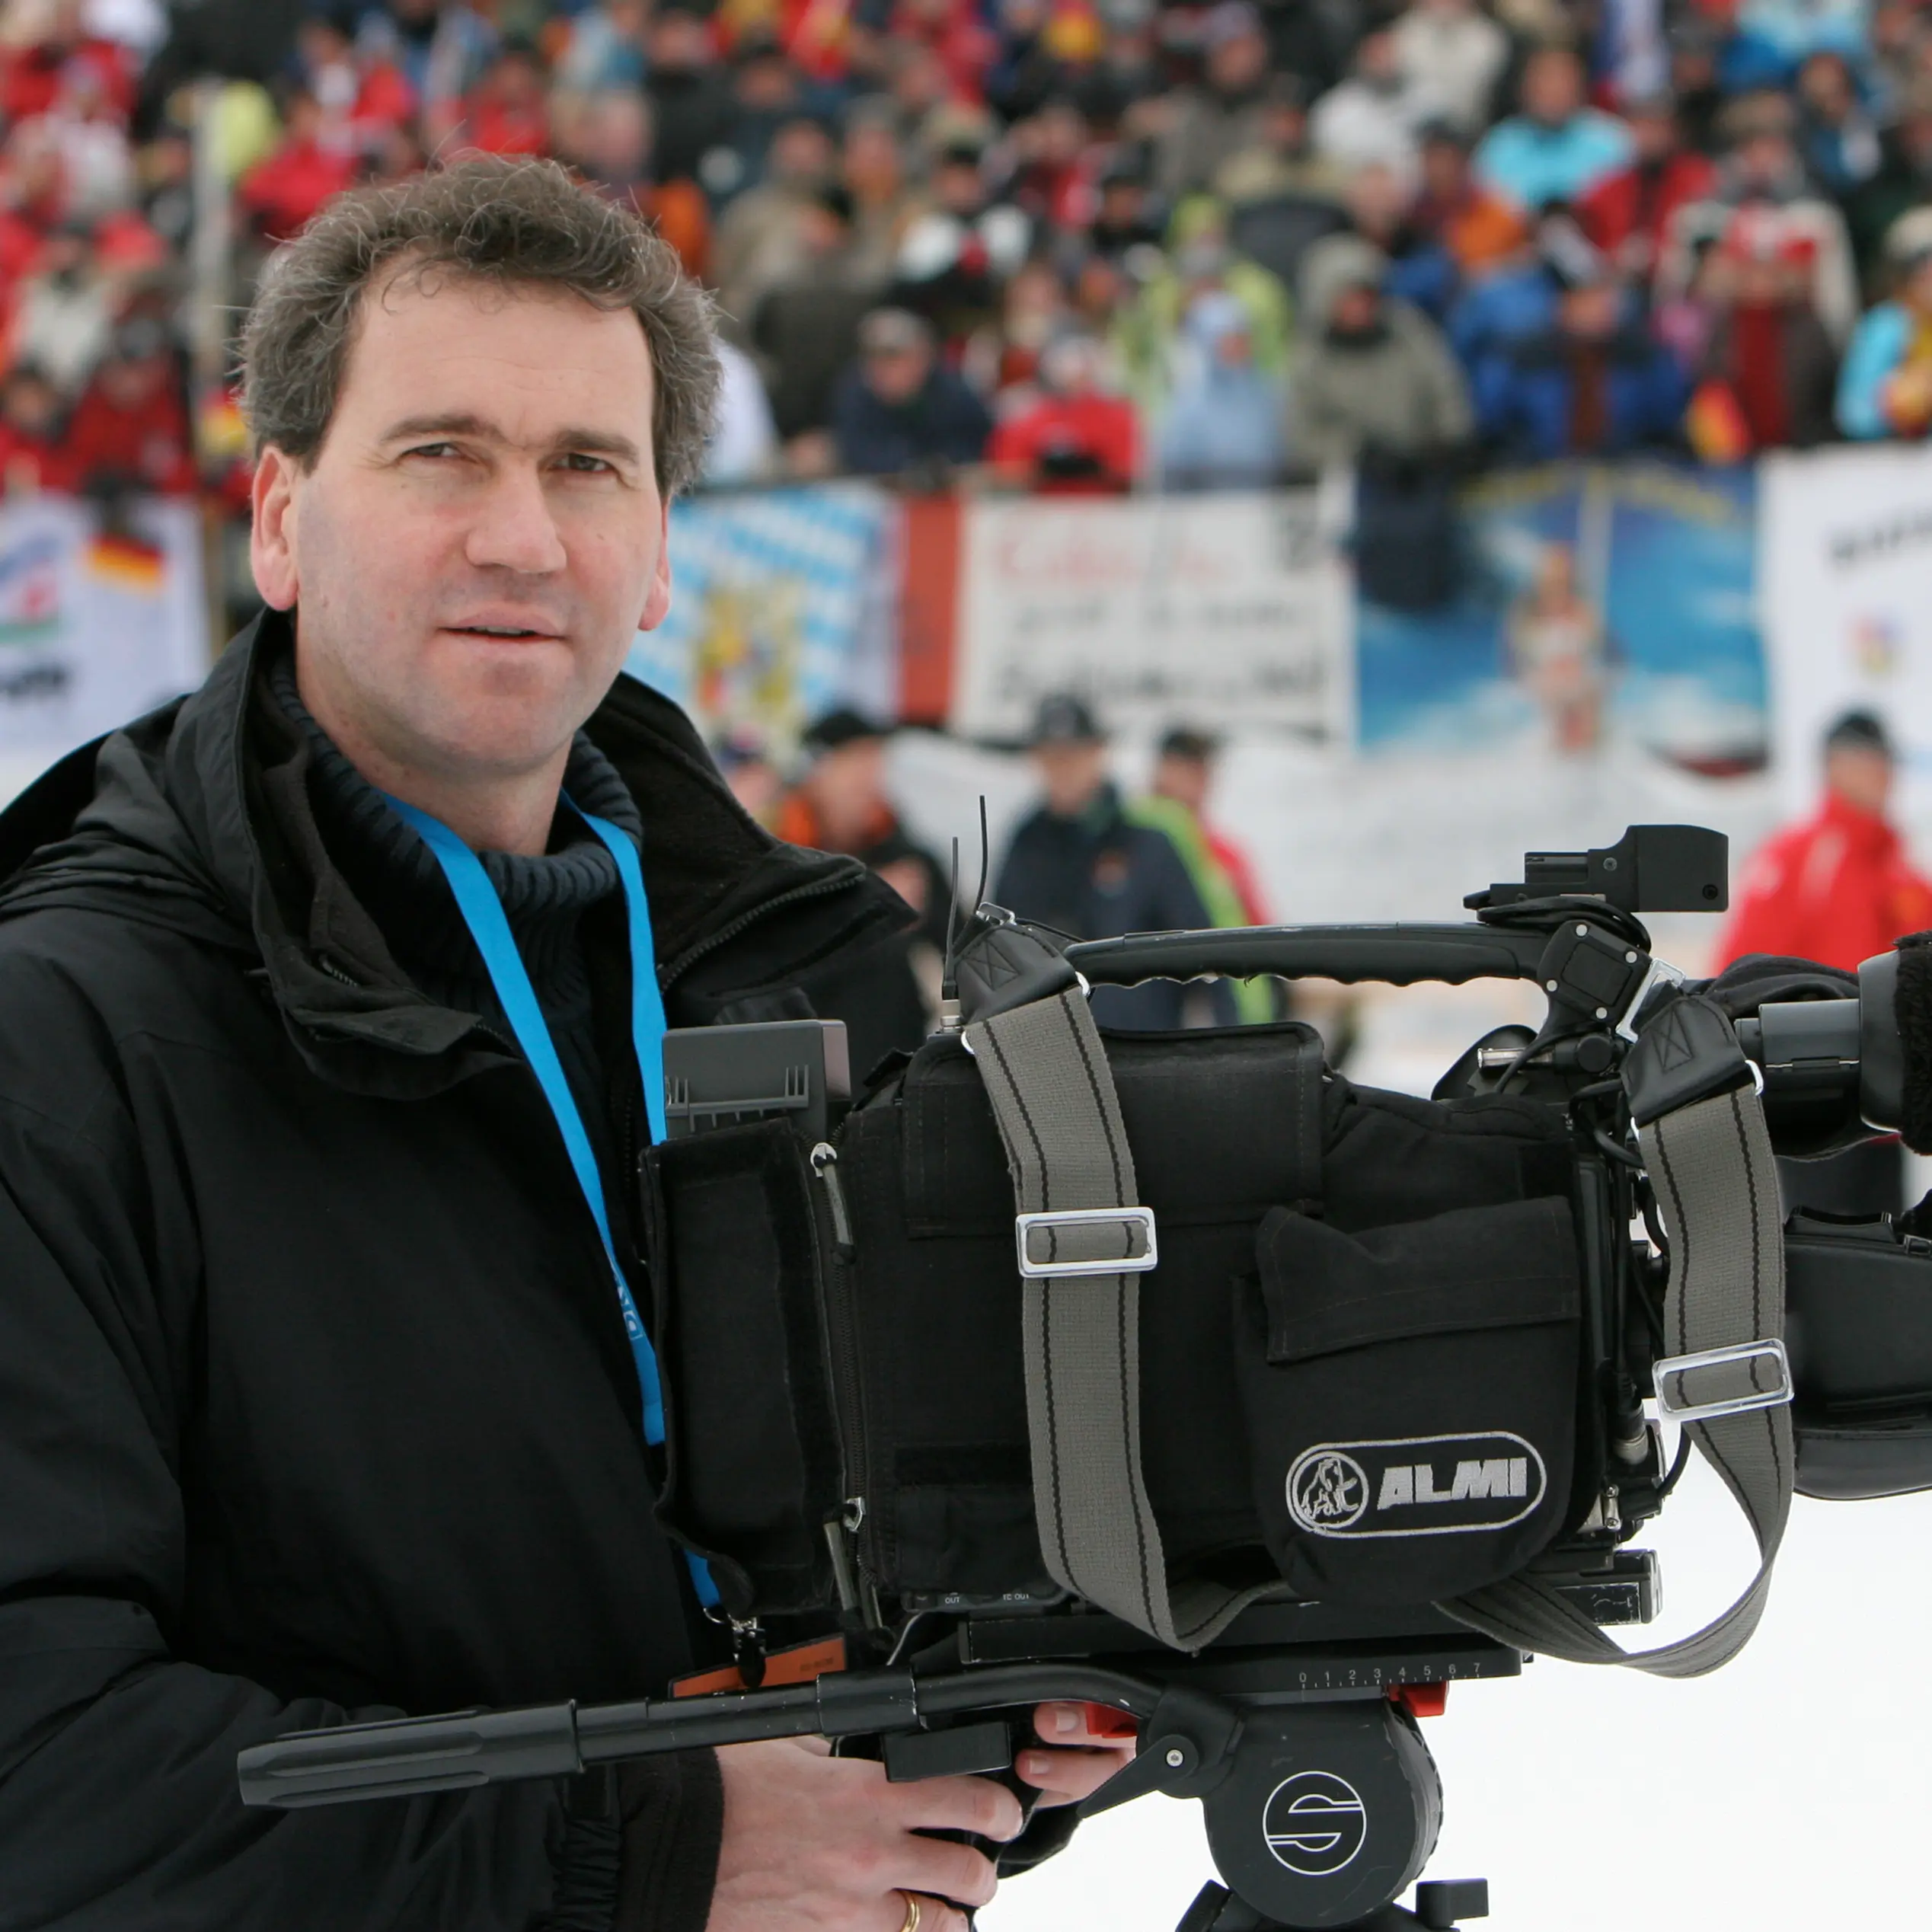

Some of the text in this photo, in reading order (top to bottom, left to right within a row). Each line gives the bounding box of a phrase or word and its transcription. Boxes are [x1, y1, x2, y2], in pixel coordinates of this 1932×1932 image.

[1377, 1457, 1528, 1511] ALMI
[1299, 1662, 1481, 1683] 0 1 2 3 4 5 6 7
